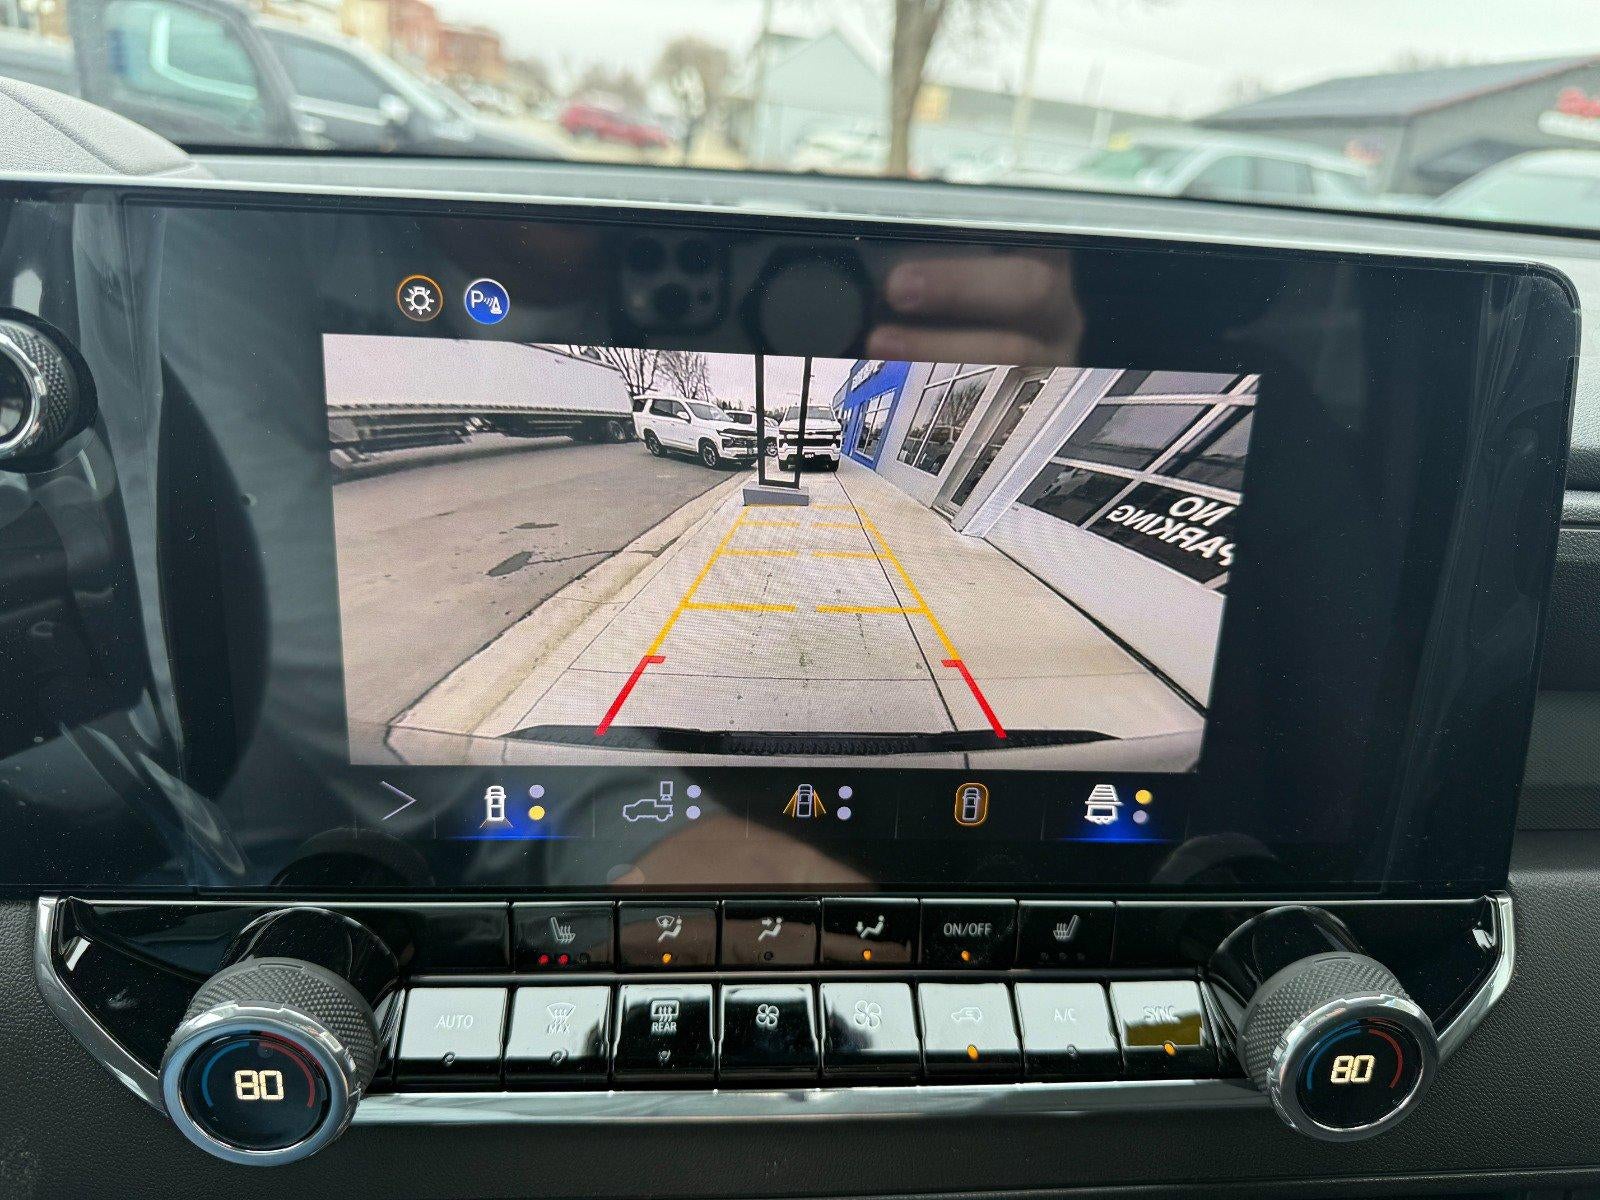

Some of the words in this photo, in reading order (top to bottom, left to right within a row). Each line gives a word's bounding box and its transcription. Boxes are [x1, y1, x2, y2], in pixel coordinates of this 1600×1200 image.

[943, 922, 991, 937] ON/OFF
[436, 1014, 474, 1029] AUTO
[1053, 1008, 1077, 1022] A/C
[1143, 1005, 1180, 1023] SYNC
[547, 1023, 571, 1035] MAX
[651, 1020, 677, 1033] REAR
[1330, 1054, 1375, 1084] 80
[234, 1070, 284, 1101] 80
